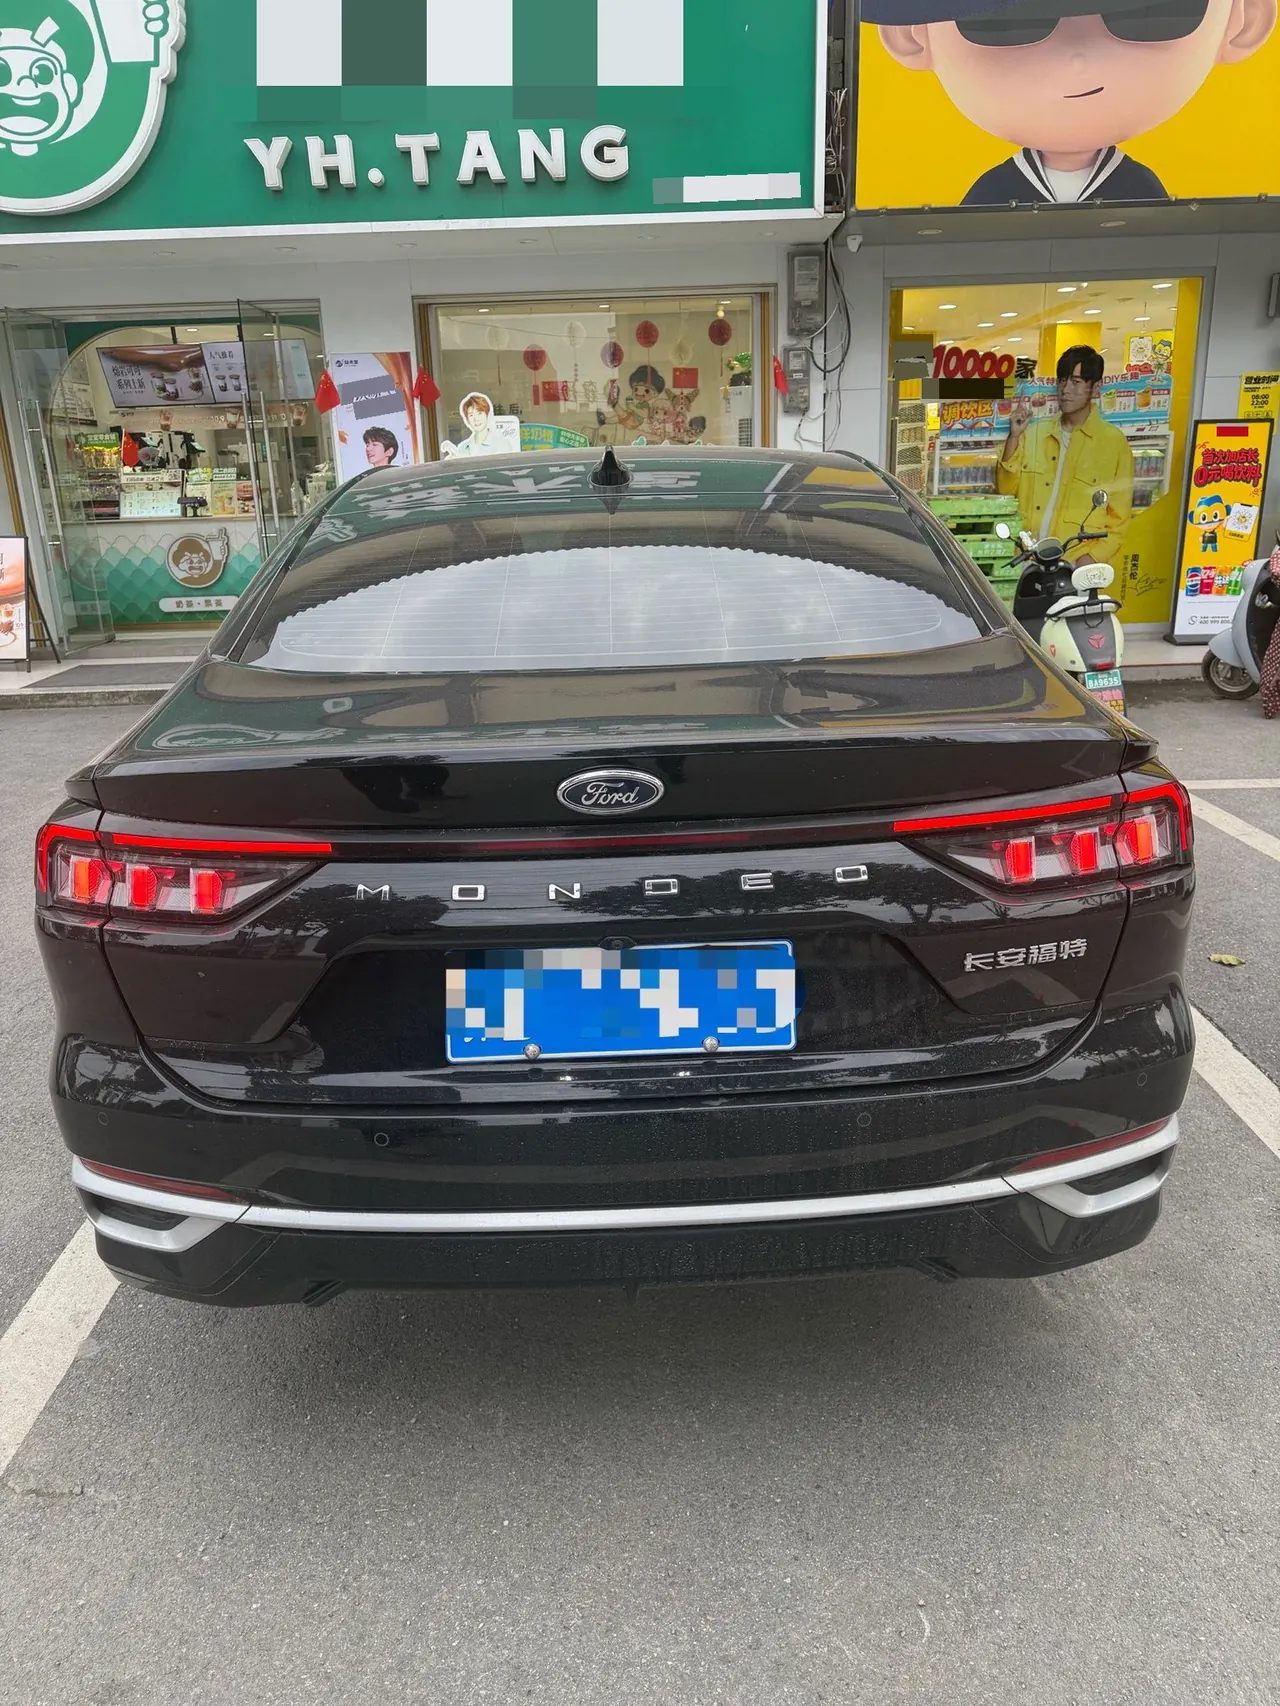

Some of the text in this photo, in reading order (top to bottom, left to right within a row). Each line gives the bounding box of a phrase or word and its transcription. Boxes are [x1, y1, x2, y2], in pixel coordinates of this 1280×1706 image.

[243, 124, 630, 191] YH.TANG
[1244, 374, 1280, 385] 营业时间
[942, 401, 994, 425] 调饮区
[1202, 448, 1260, 466] 首次加店长
[1194, 463, 1263, 487] 0元喝饮料
[580, 781, 640, 807] Ford
[356, 864, 870, 902] MONDEO
[963, 938, 1088, 972] 长安福特
